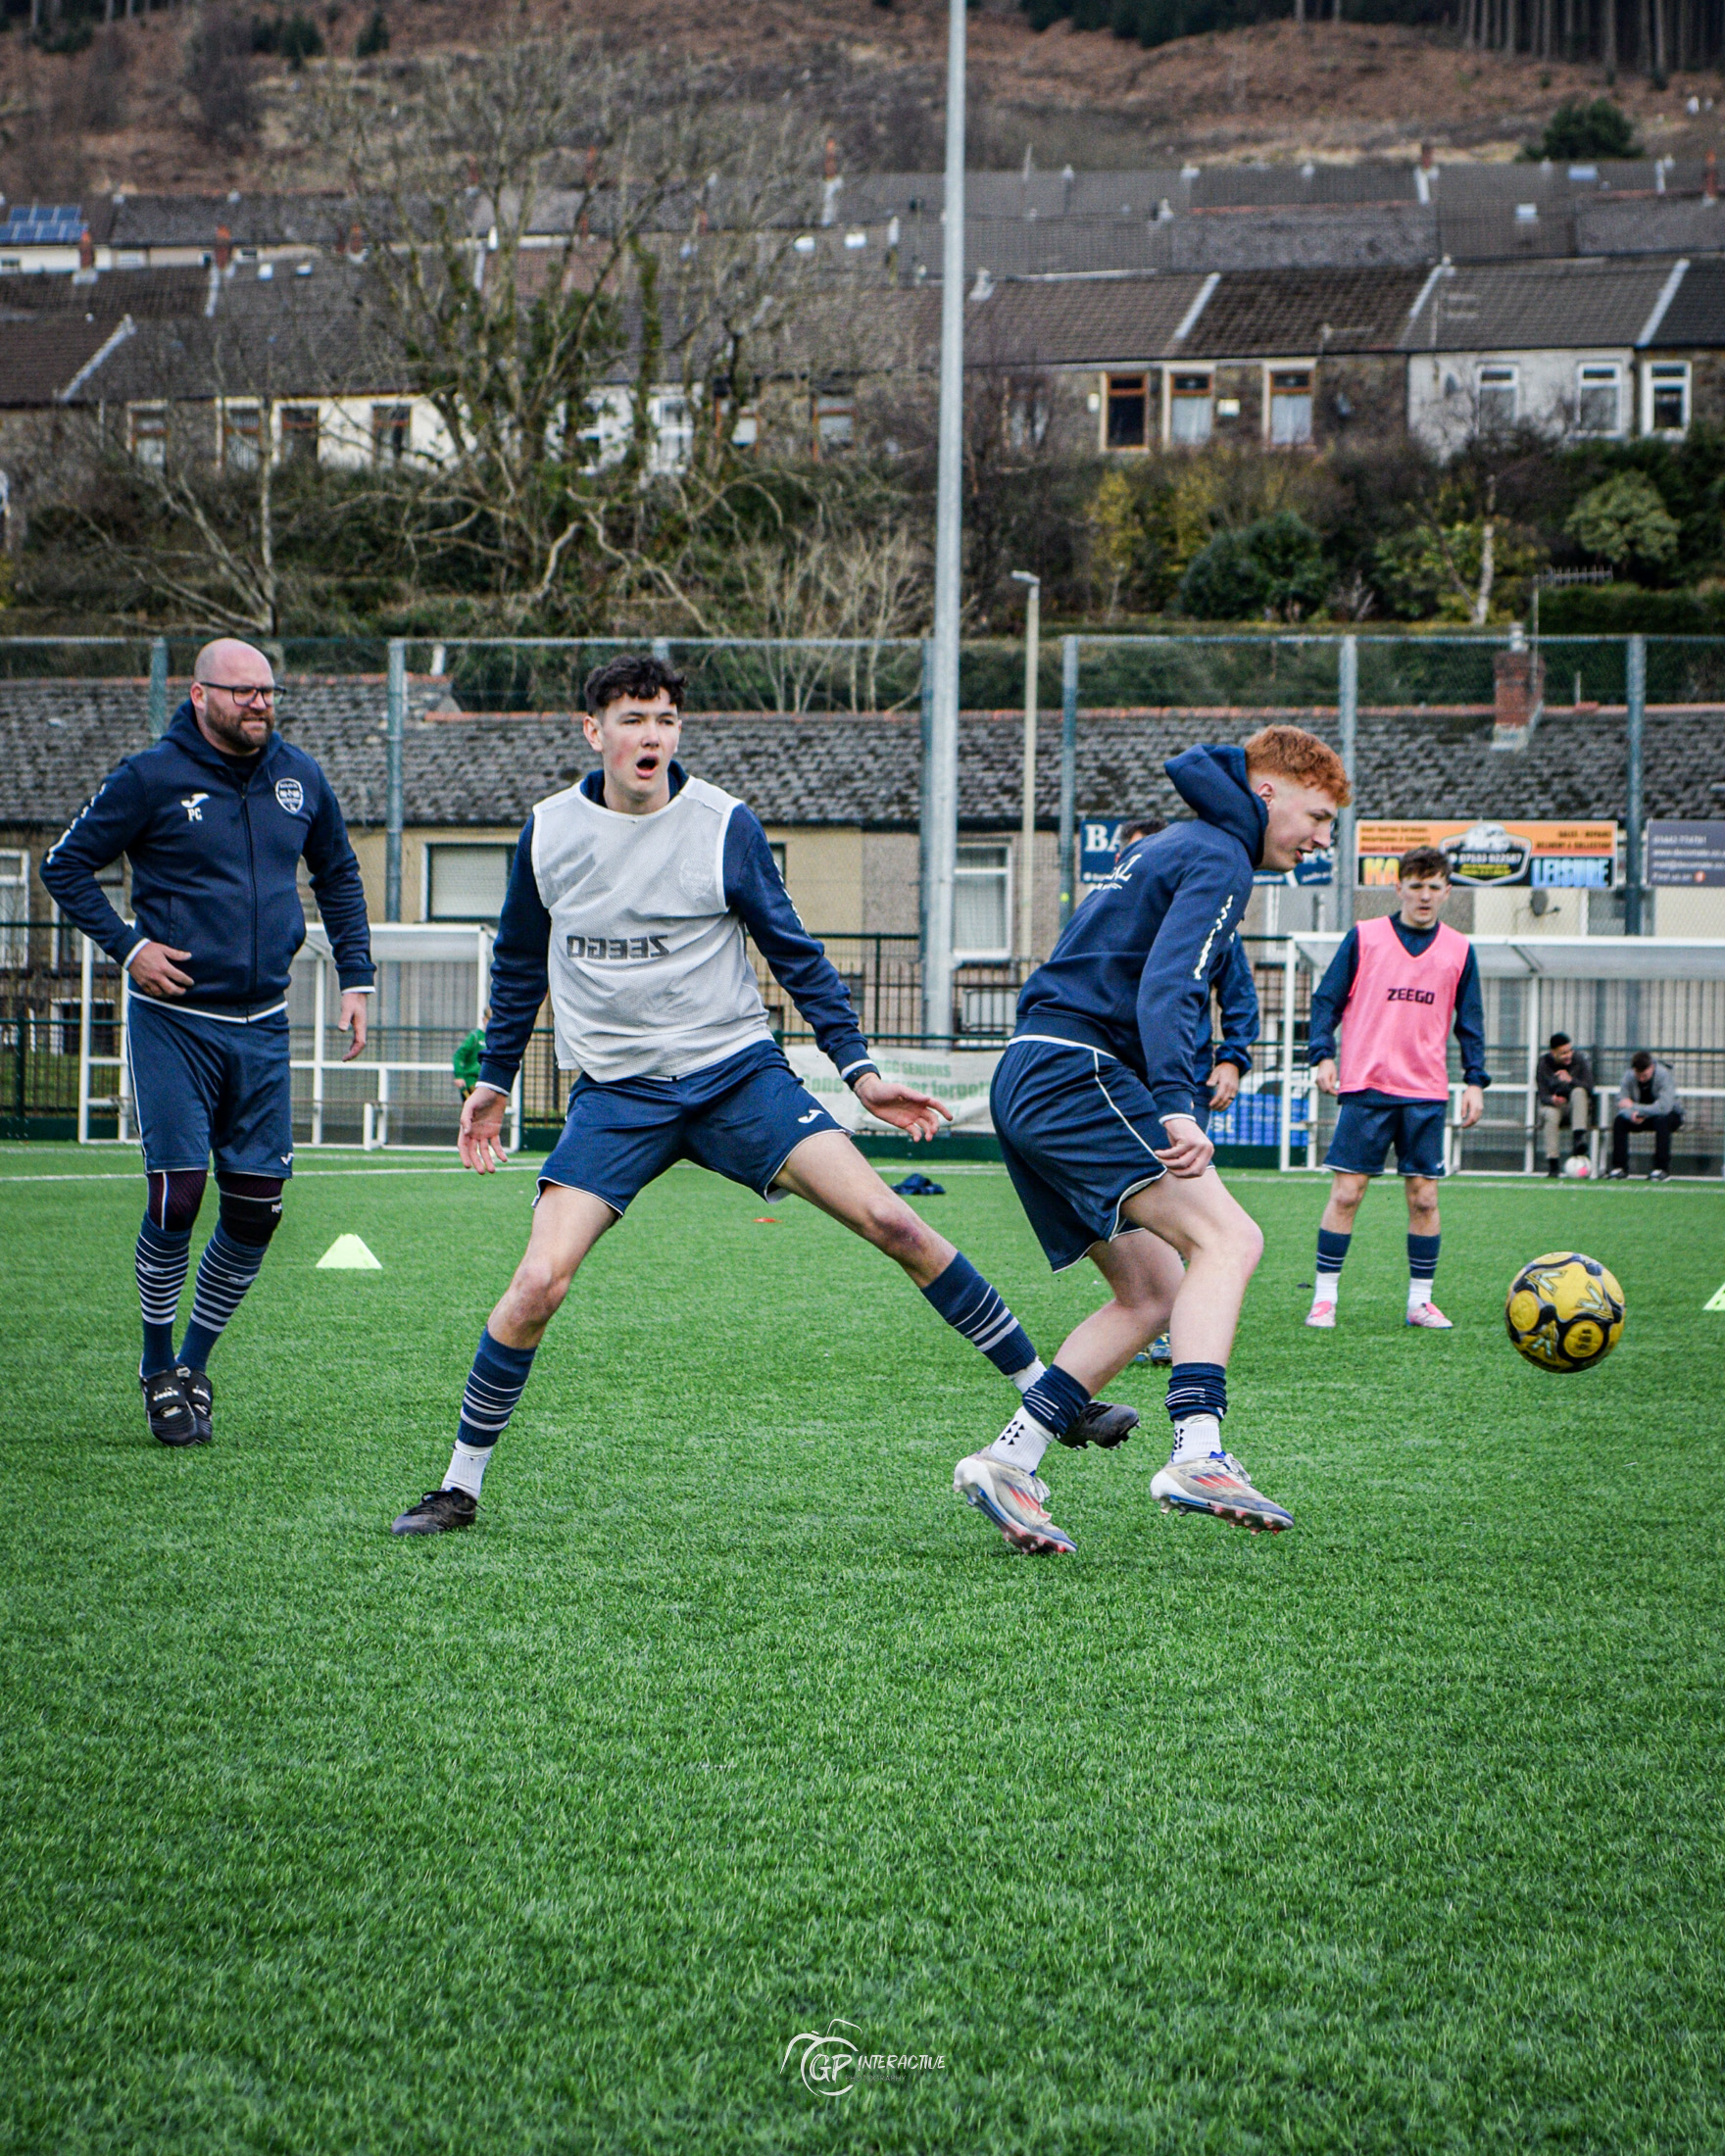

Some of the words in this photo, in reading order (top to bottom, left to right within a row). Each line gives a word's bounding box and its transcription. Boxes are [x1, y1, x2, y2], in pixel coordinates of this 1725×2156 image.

[187, 807, 203, 821] PC
[1532, 858, 1609, 887] LEISURE
[1387, 988, 1435, 1004] ZEEGO
